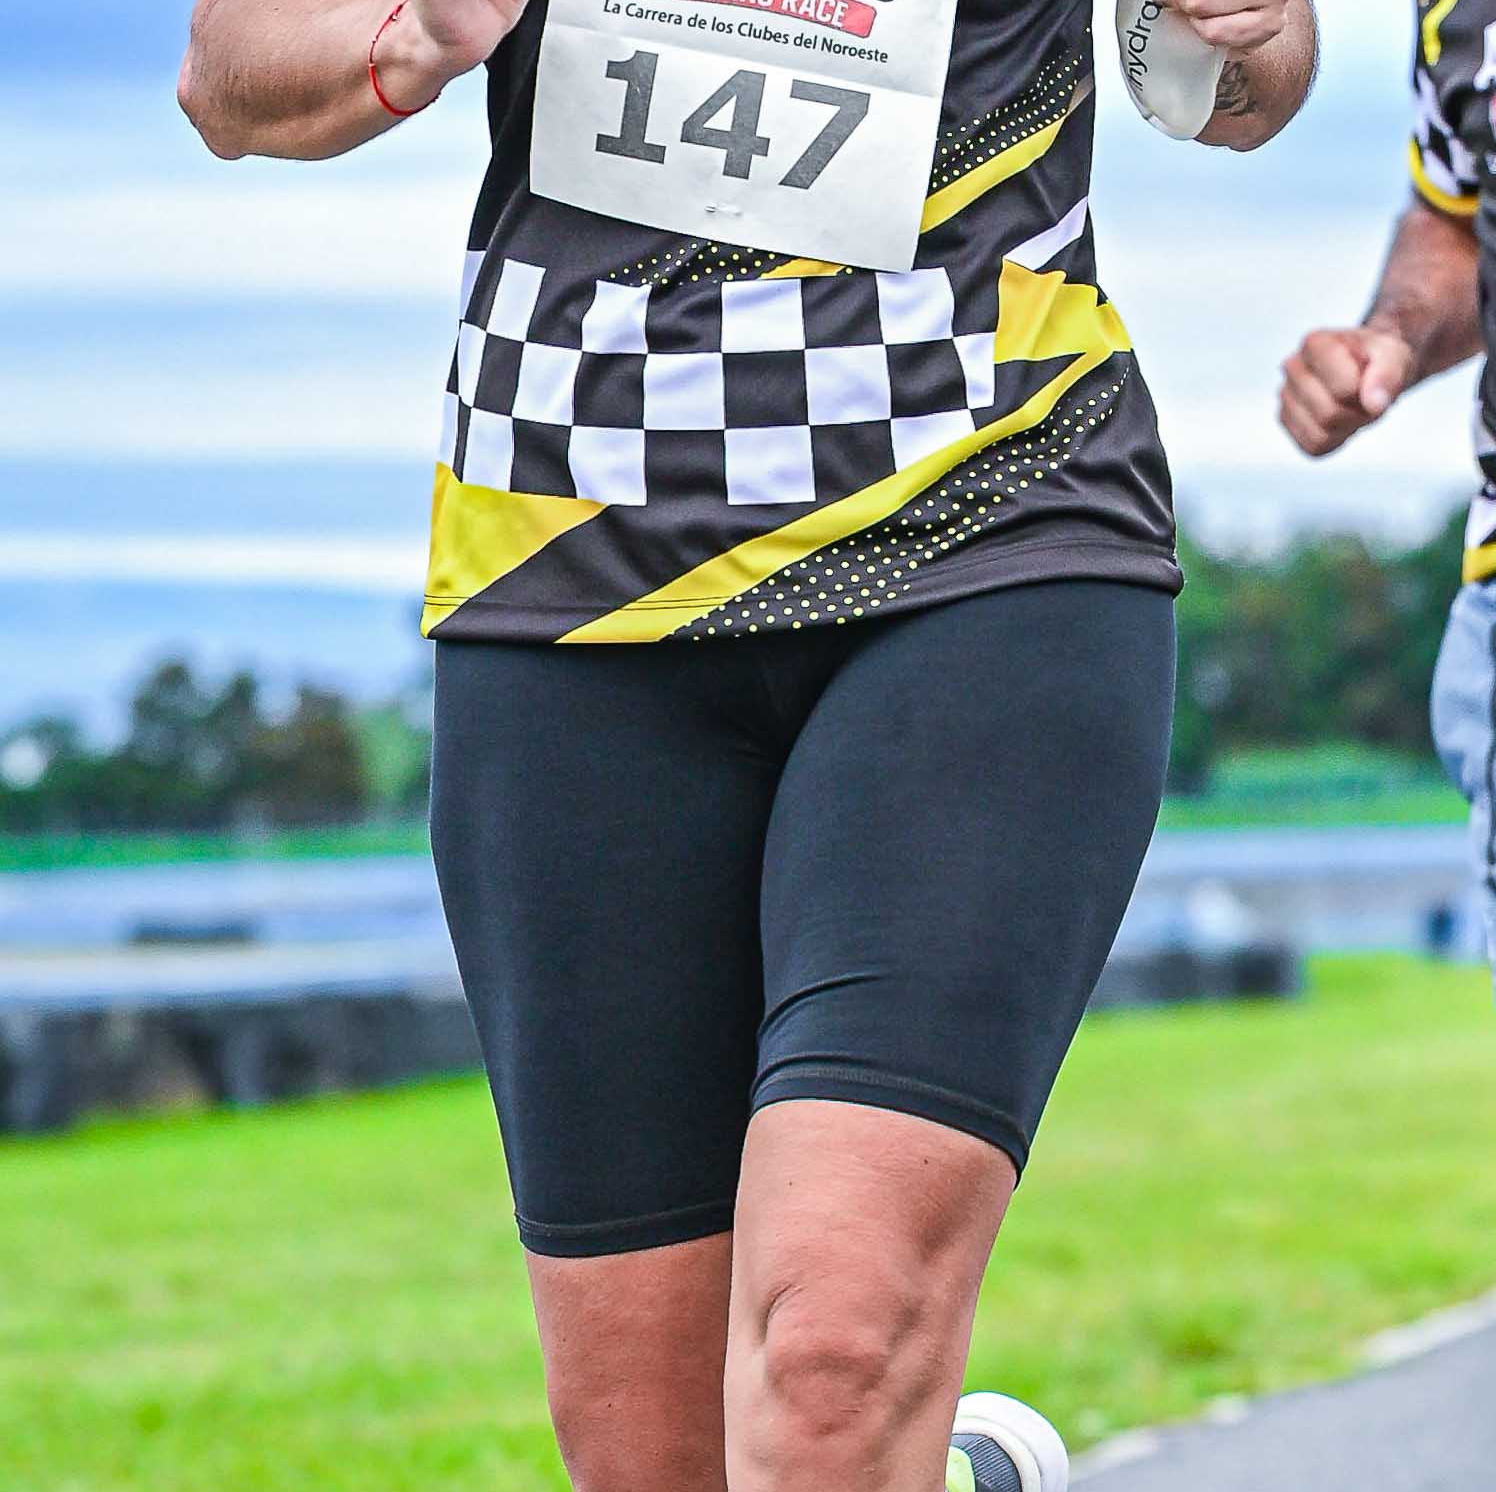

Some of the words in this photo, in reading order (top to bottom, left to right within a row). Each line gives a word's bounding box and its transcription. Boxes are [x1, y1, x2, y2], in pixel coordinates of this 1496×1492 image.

[625, 3, 683, 25] Carrera
[687, 16, 707, 30] de
[711, 17, 733, 35] los
[737, 22, 790, 45] Clubes
[793, 32, 818, 50] del
[820, 37, 889, 64] Noroeste
[595, 50, 871, 189] 147
